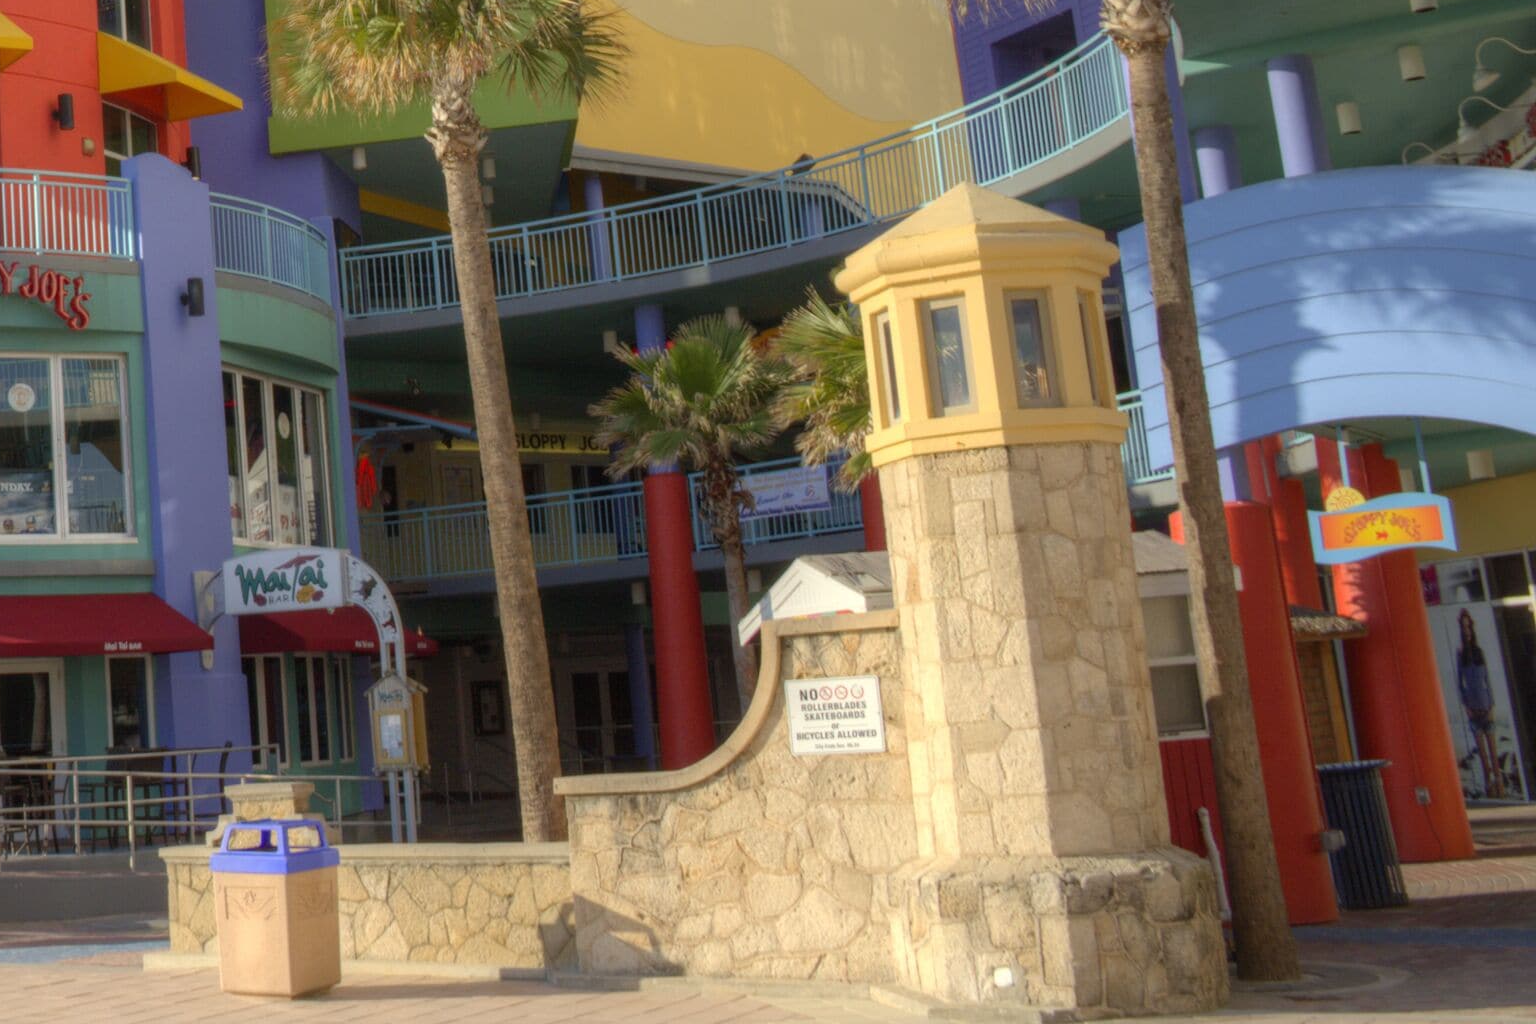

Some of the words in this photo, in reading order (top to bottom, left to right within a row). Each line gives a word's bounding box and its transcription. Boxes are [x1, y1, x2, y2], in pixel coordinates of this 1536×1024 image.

[19, 264, 92, 331] JOE'S
[235, 563, 291, 606] Mai
[275, 554, 328, 602] Tai
[269, 594, 289, 606] BAR
[799, 688, 818, 701] NO
[801, 701, 867, 712] ROLLERBLADES
[804, 710, 866, 721] SKATEBOARDS
[796, 730, 835, 741] BICYCLES
[837, 729, 877, 739] ALLOWED
